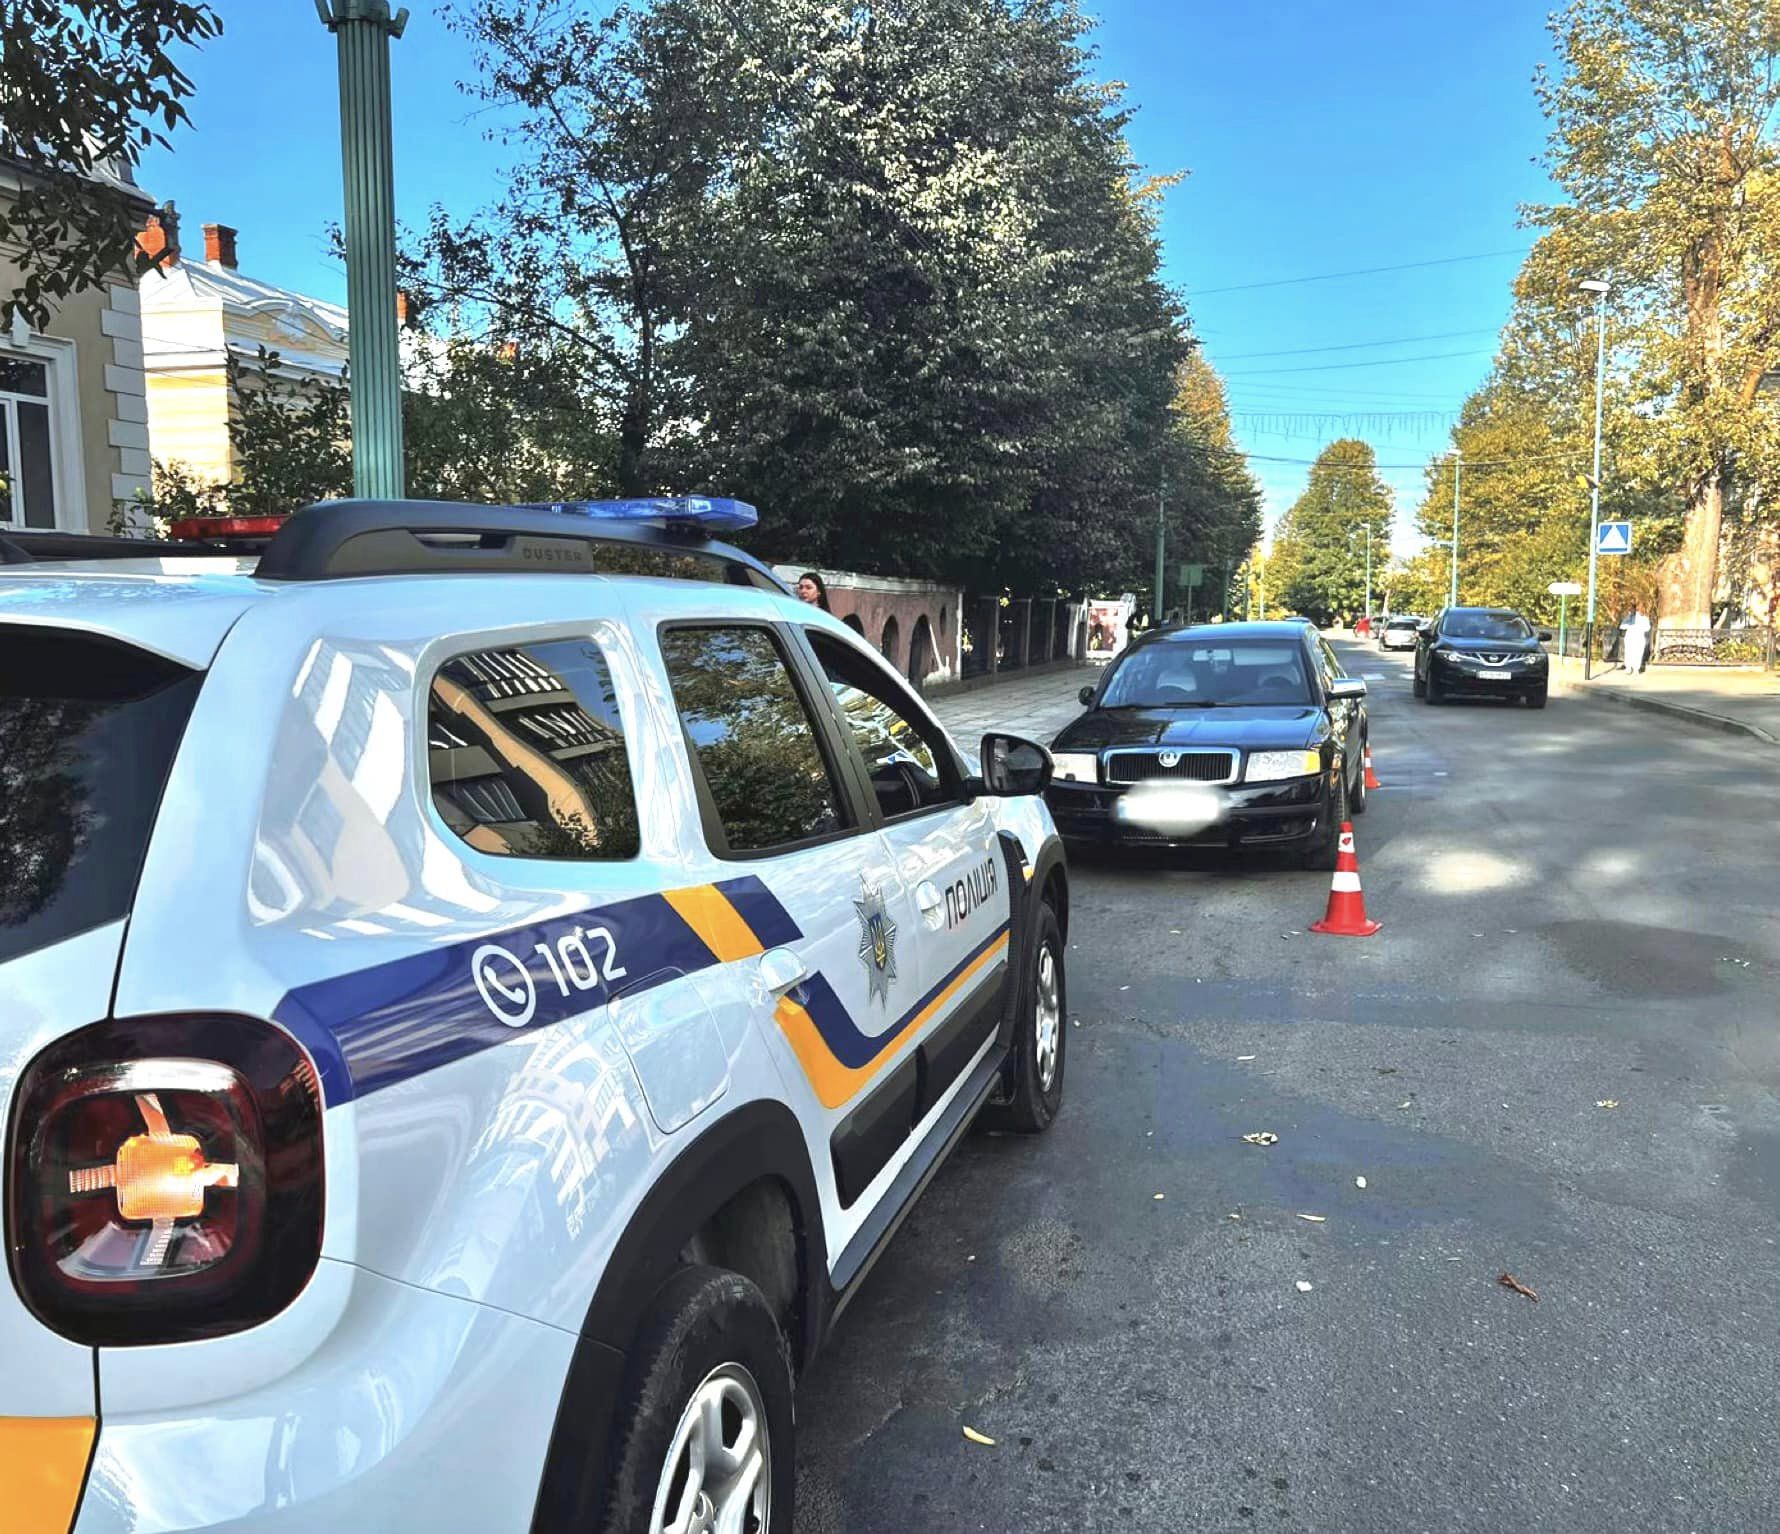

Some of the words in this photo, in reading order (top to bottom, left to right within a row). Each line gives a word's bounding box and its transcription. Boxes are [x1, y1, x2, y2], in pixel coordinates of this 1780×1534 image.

[522, 547, 582, 561] DUSTER
[945, 858, 998, 930] ПОЛІЦІЯ
[534, 926, 627, 997] 102
